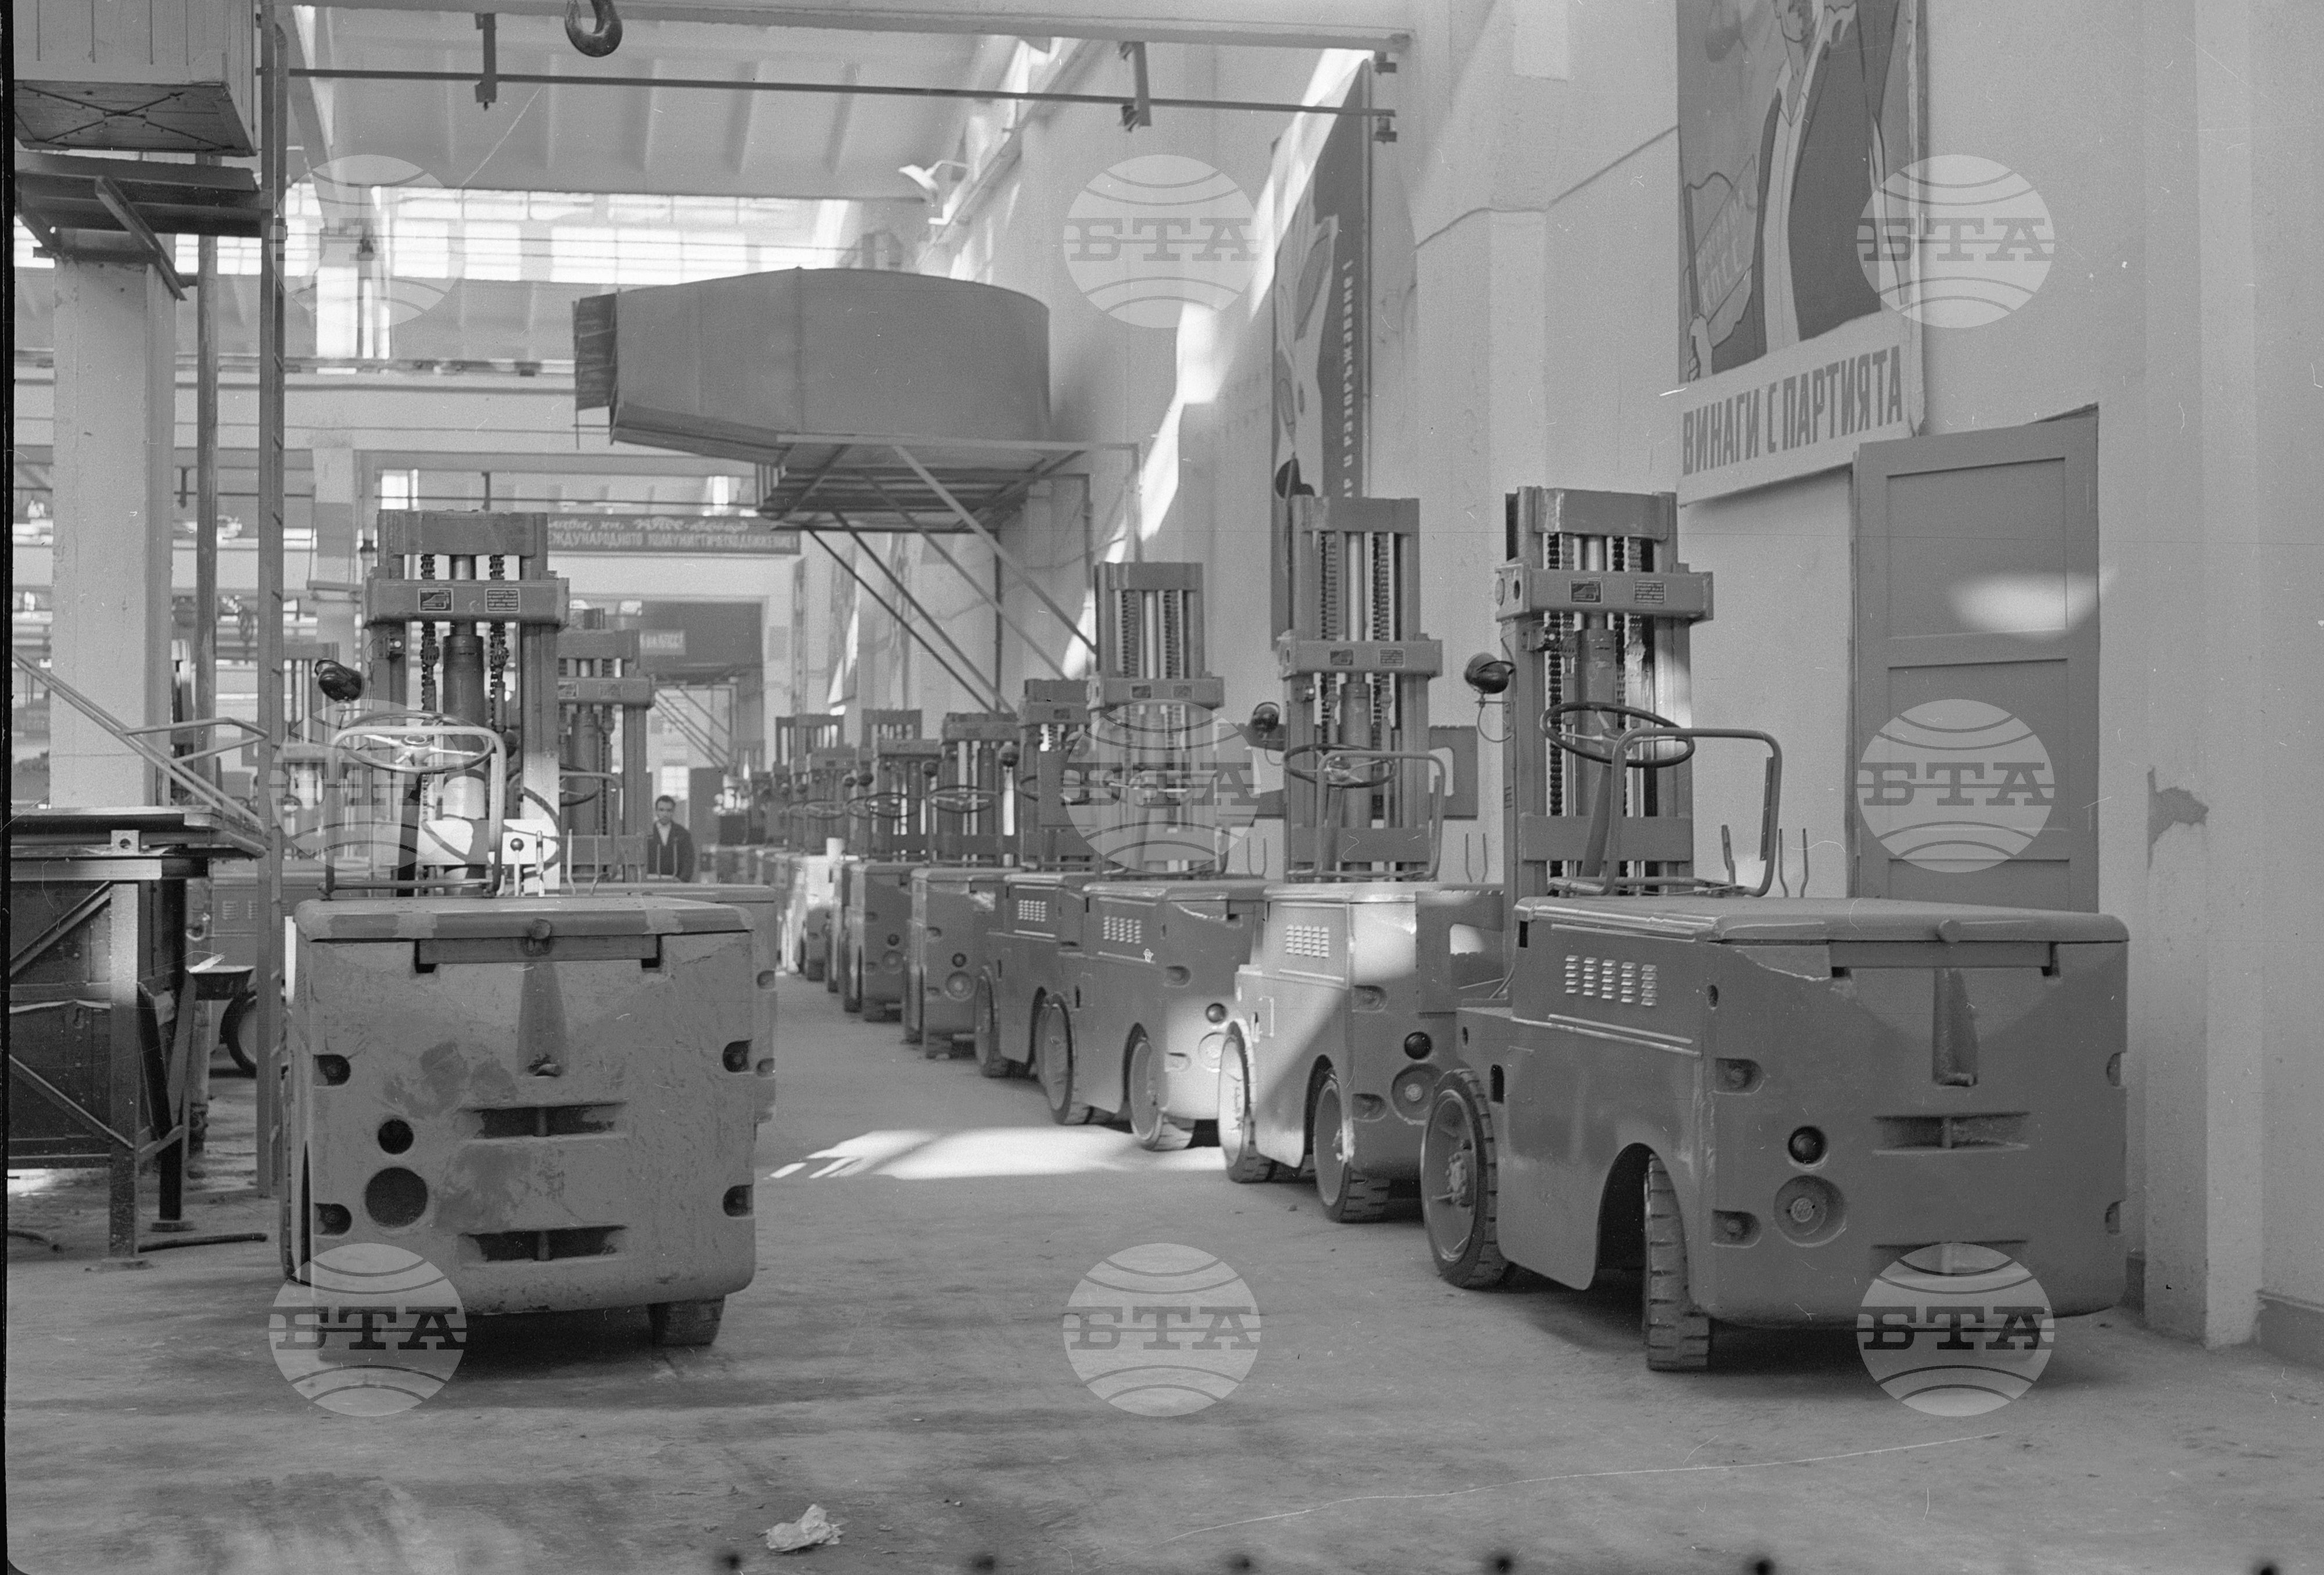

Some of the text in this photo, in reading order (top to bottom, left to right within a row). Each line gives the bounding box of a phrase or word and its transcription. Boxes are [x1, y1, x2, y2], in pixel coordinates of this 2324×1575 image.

[1700, 237, 1742, 316] КПСС
[1683, 345, 1902, 475] ВИНАГИ С ПАРТИЯТА
